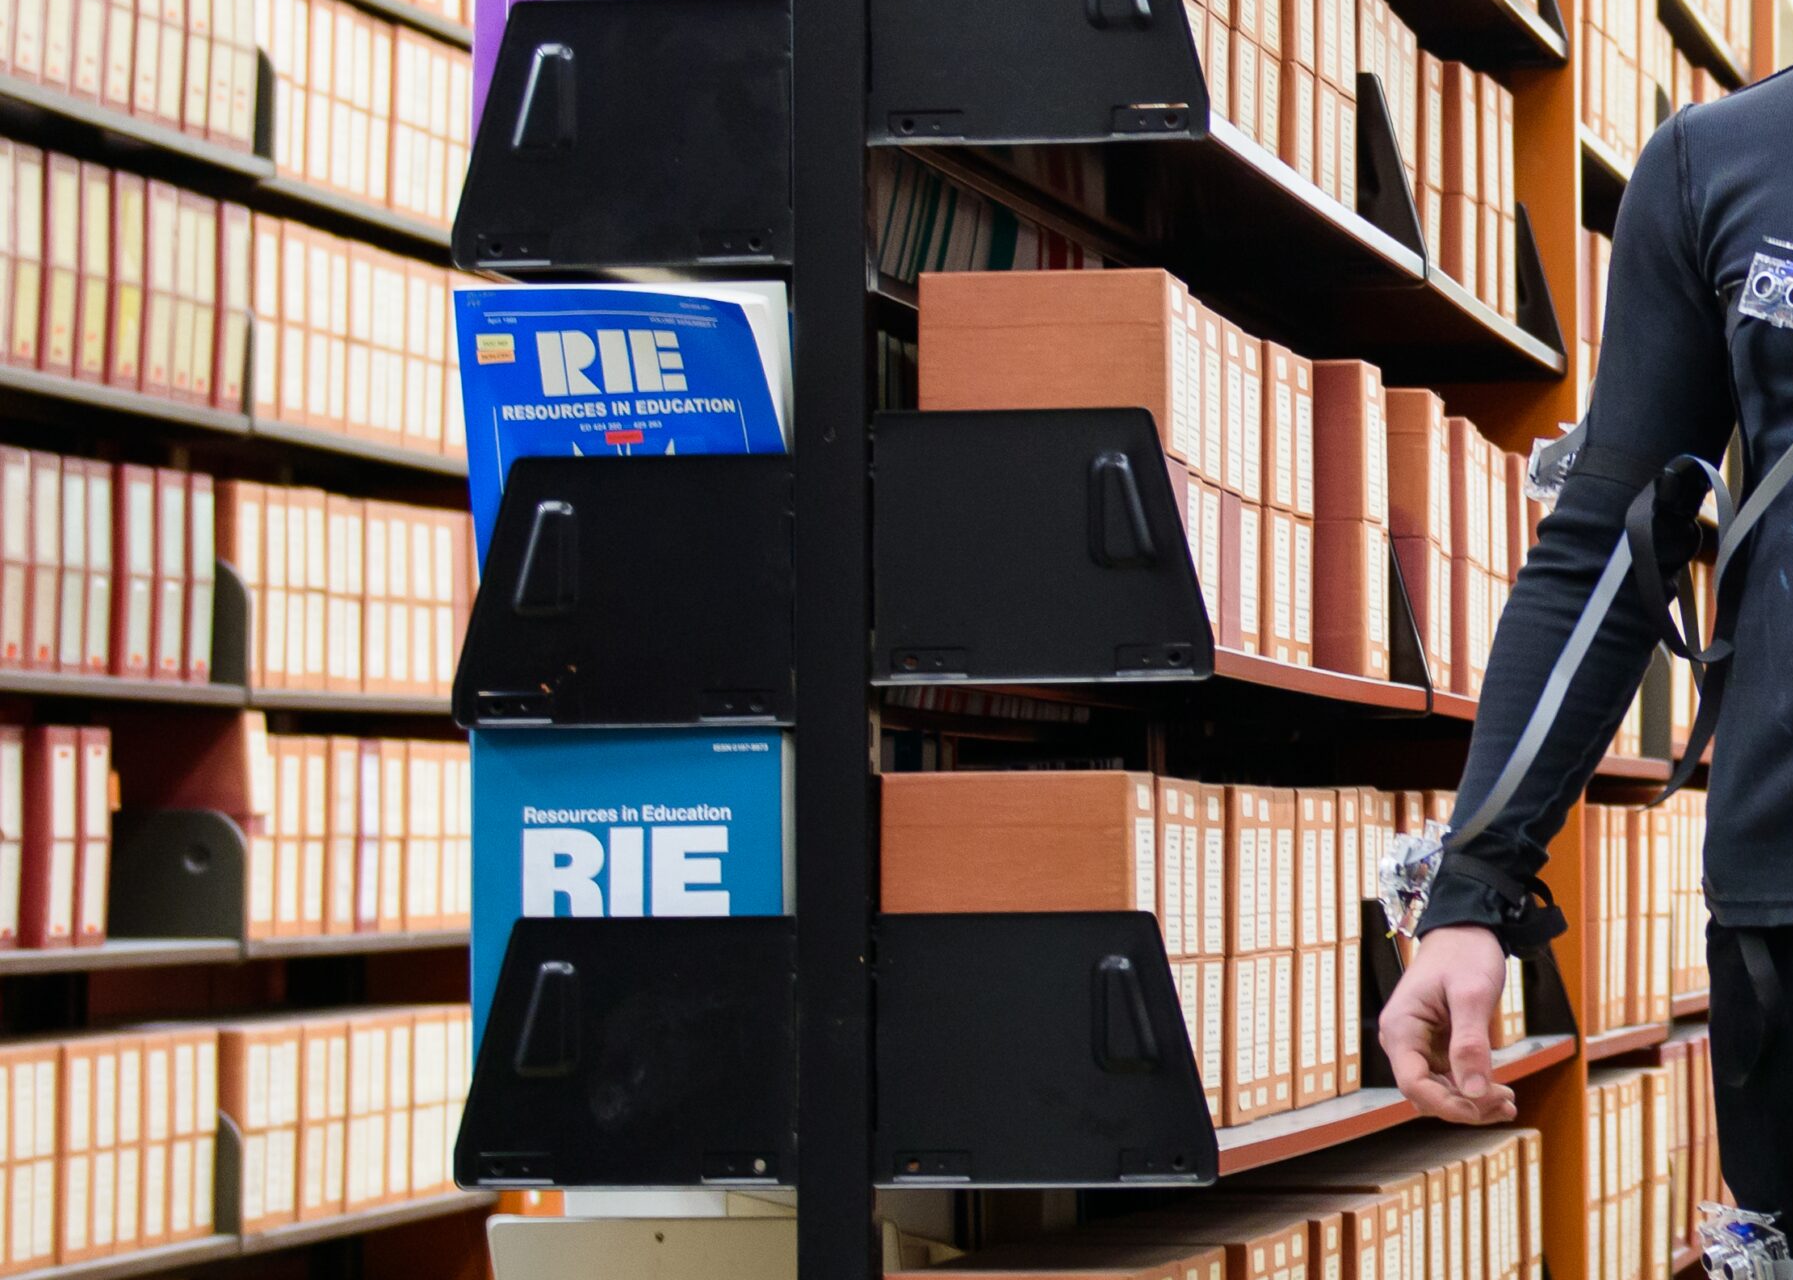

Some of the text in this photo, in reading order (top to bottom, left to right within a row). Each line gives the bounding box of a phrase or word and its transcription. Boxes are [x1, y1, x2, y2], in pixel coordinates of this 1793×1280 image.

[535, 328, 689, 398] RIE
[502, 398, 736, 421] RESOURCES IN EDUCATION
[523, 803, 732, 825] Resources in Education
[522, 826, 731, 917] RIE
